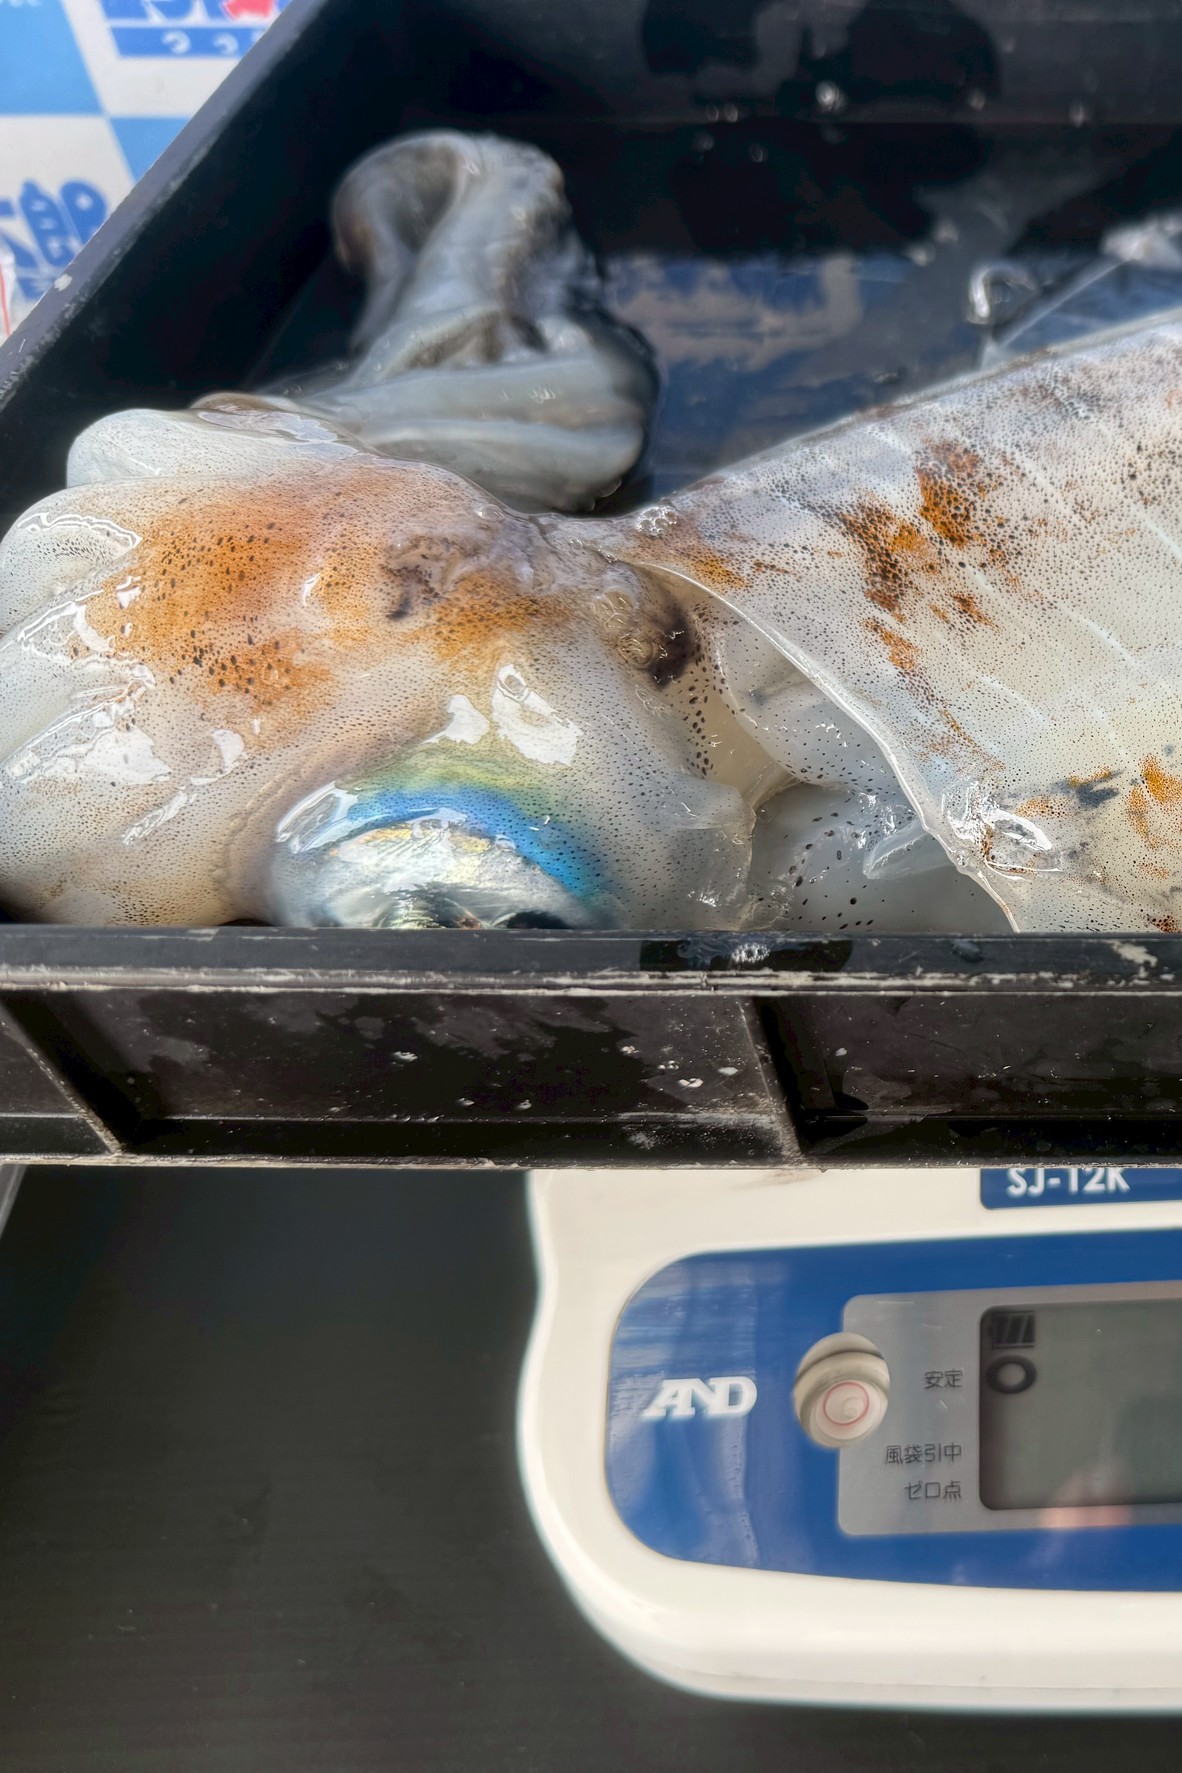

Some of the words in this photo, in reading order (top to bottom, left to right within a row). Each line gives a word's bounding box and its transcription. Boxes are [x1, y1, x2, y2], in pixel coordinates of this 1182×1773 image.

[1007, 1167, 1130, 1197] SJ-12K
[924, 1369, 964, 1390] 安定
[885, 1443, 963, 1466] 風袋引中
[904, 1481, 963, 1501] ゼロ点
